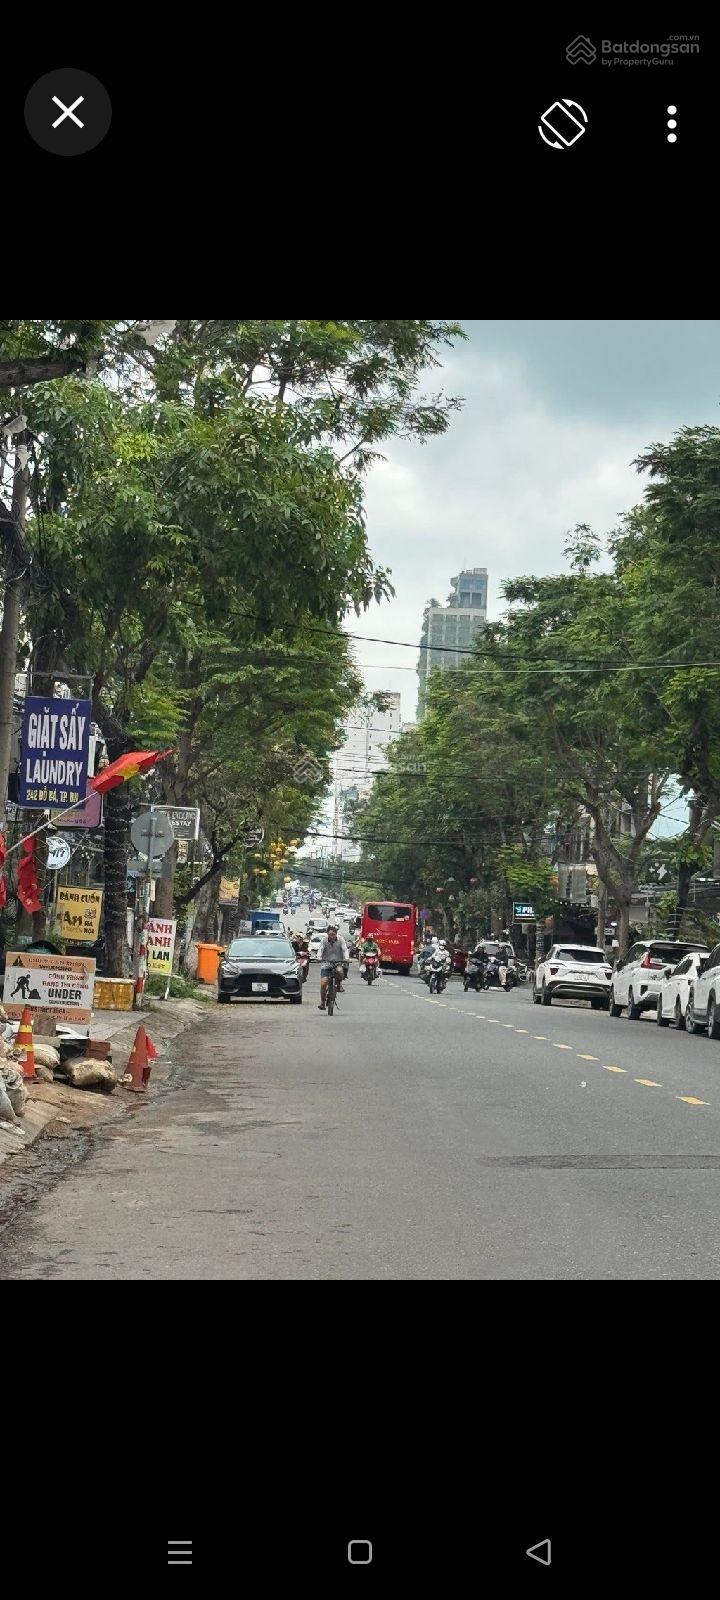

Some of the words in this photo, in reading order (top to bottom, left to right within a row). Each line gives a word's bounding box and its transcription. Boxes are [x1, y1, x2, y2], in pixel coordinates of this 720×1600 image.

[25, 758, 83, 787] LAUNDRY
[152, 950, 170, 961] LAN
[47, 987, 82, 1000] UNDER
